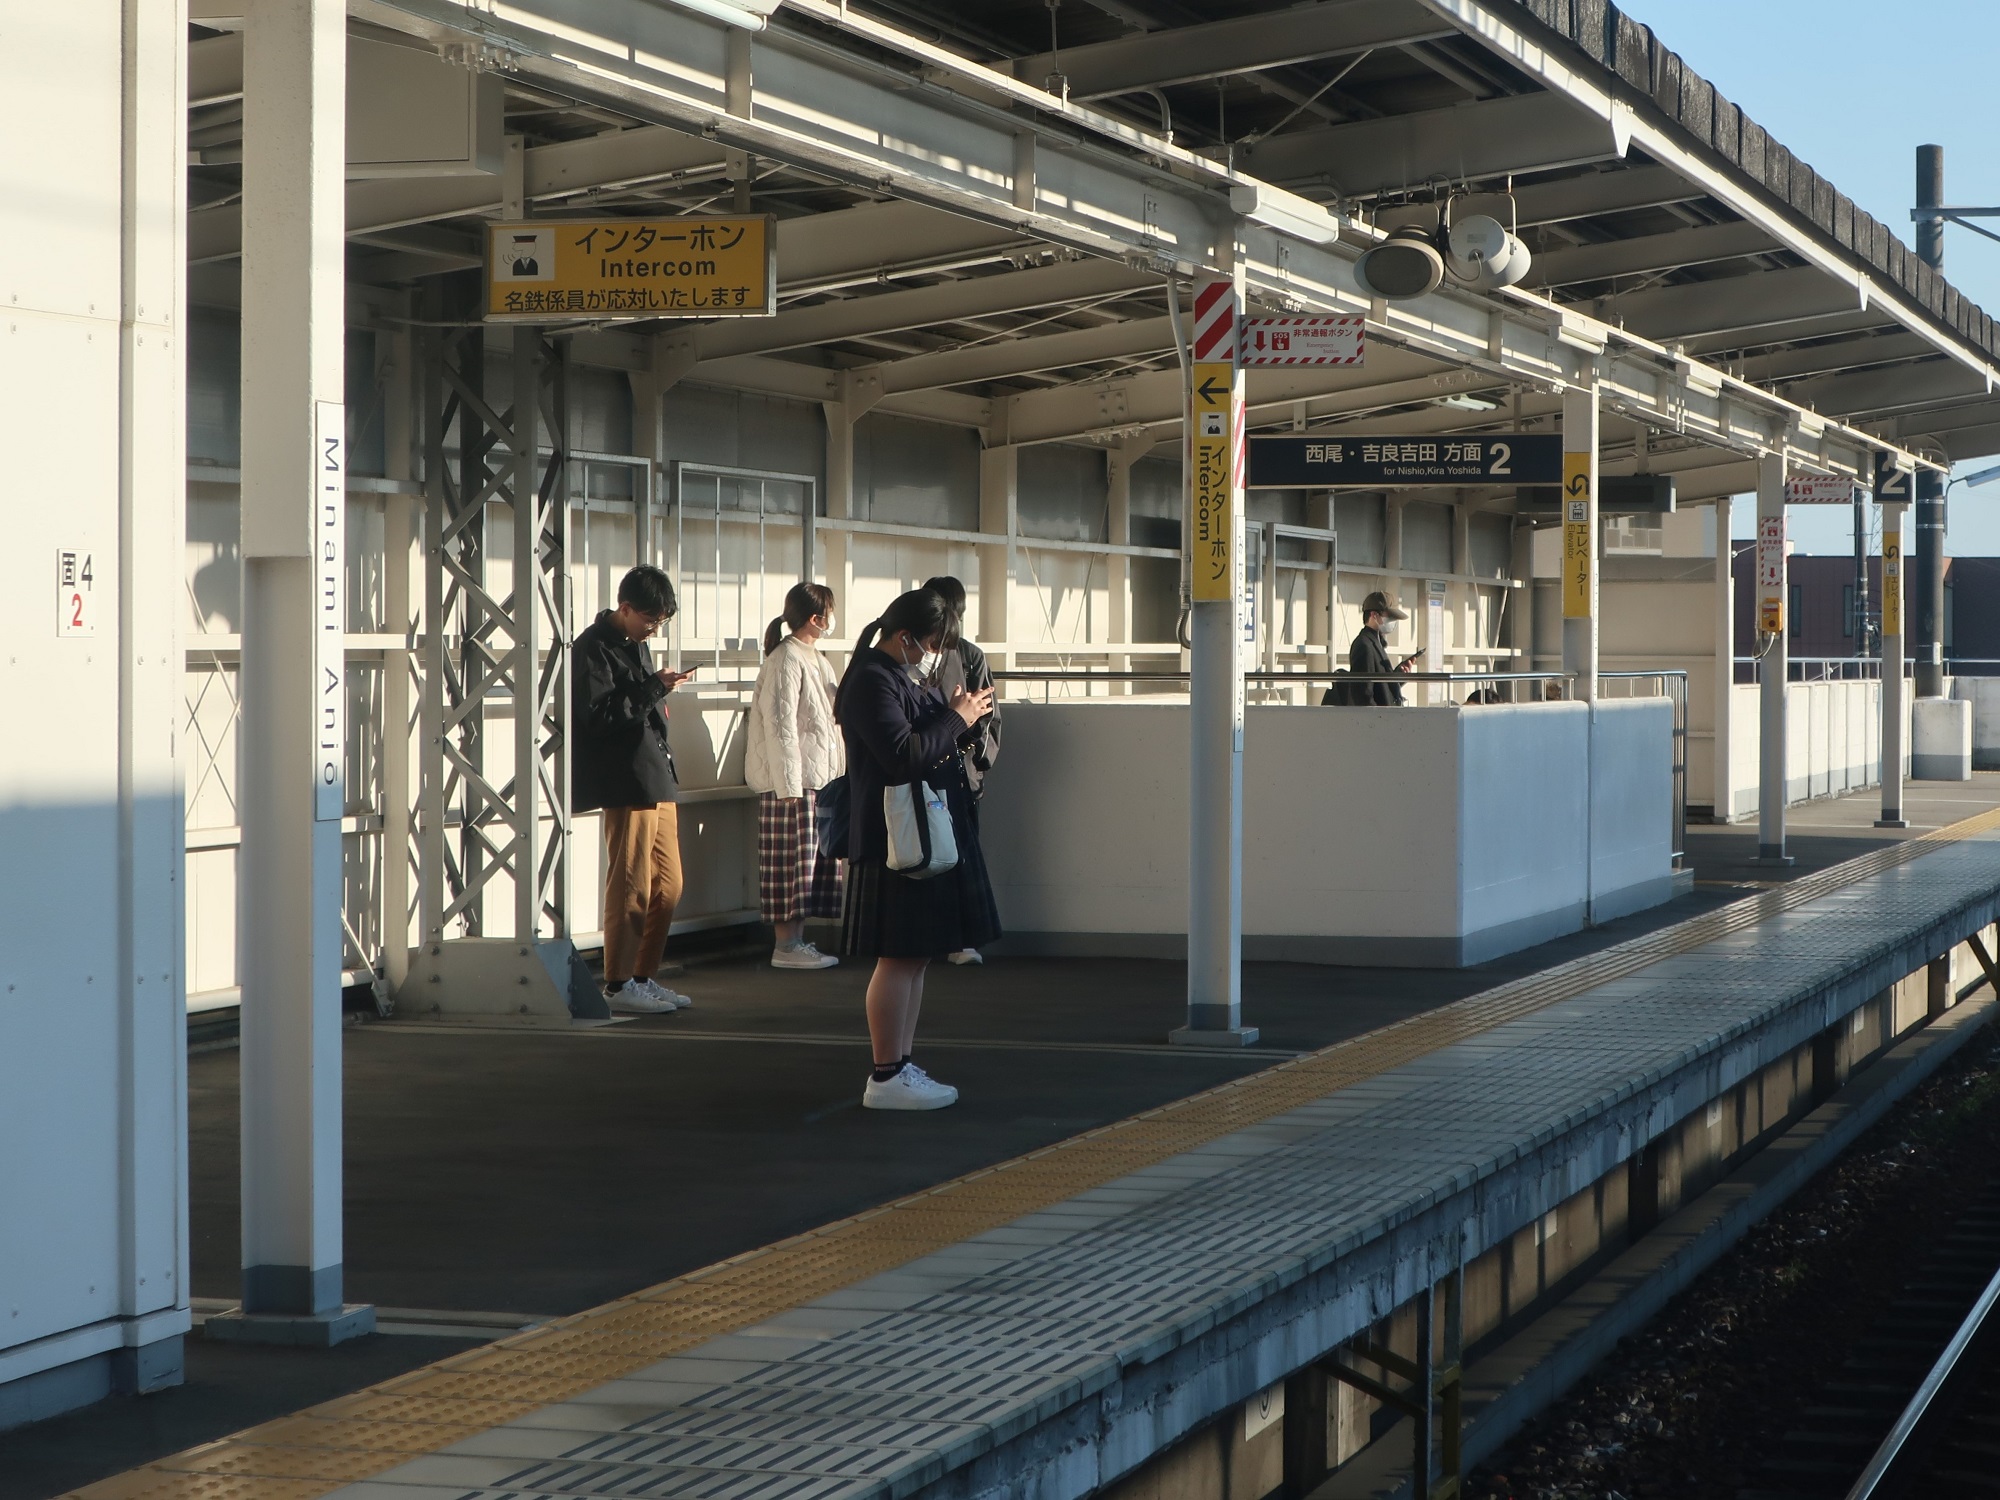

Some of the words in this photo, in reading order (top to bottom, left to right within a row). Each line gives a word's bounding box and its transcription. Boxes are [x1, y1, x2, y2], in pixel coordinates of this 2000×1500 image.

[575, 224, 745, 255] インターホン
[601, 259, 715, 278] Intercom
[504, 286, 750, 312] 名鉄係員が応対いたします
[1293, 328, 1352, 338] 非常通報ボタン
[1305, 443, 1437, 463] 西尾・吉良吉田
[1443, 443, 1482, 462] 方面
[1489, 443, 1511, 475] 2
[1384, 466, 1395, 475] for
[1447, 466, 1482, 475] Yoshida
[1881, 452, 1906, 494] 2
[1199, 445, 1212, 541] Intercom
[1211, 446, 1227, 580] インターホン
[325, 438, 340, 631] Minami
[1577, 524, 1588, 596] エレベーター
[72, 593, 83, 627] 2
